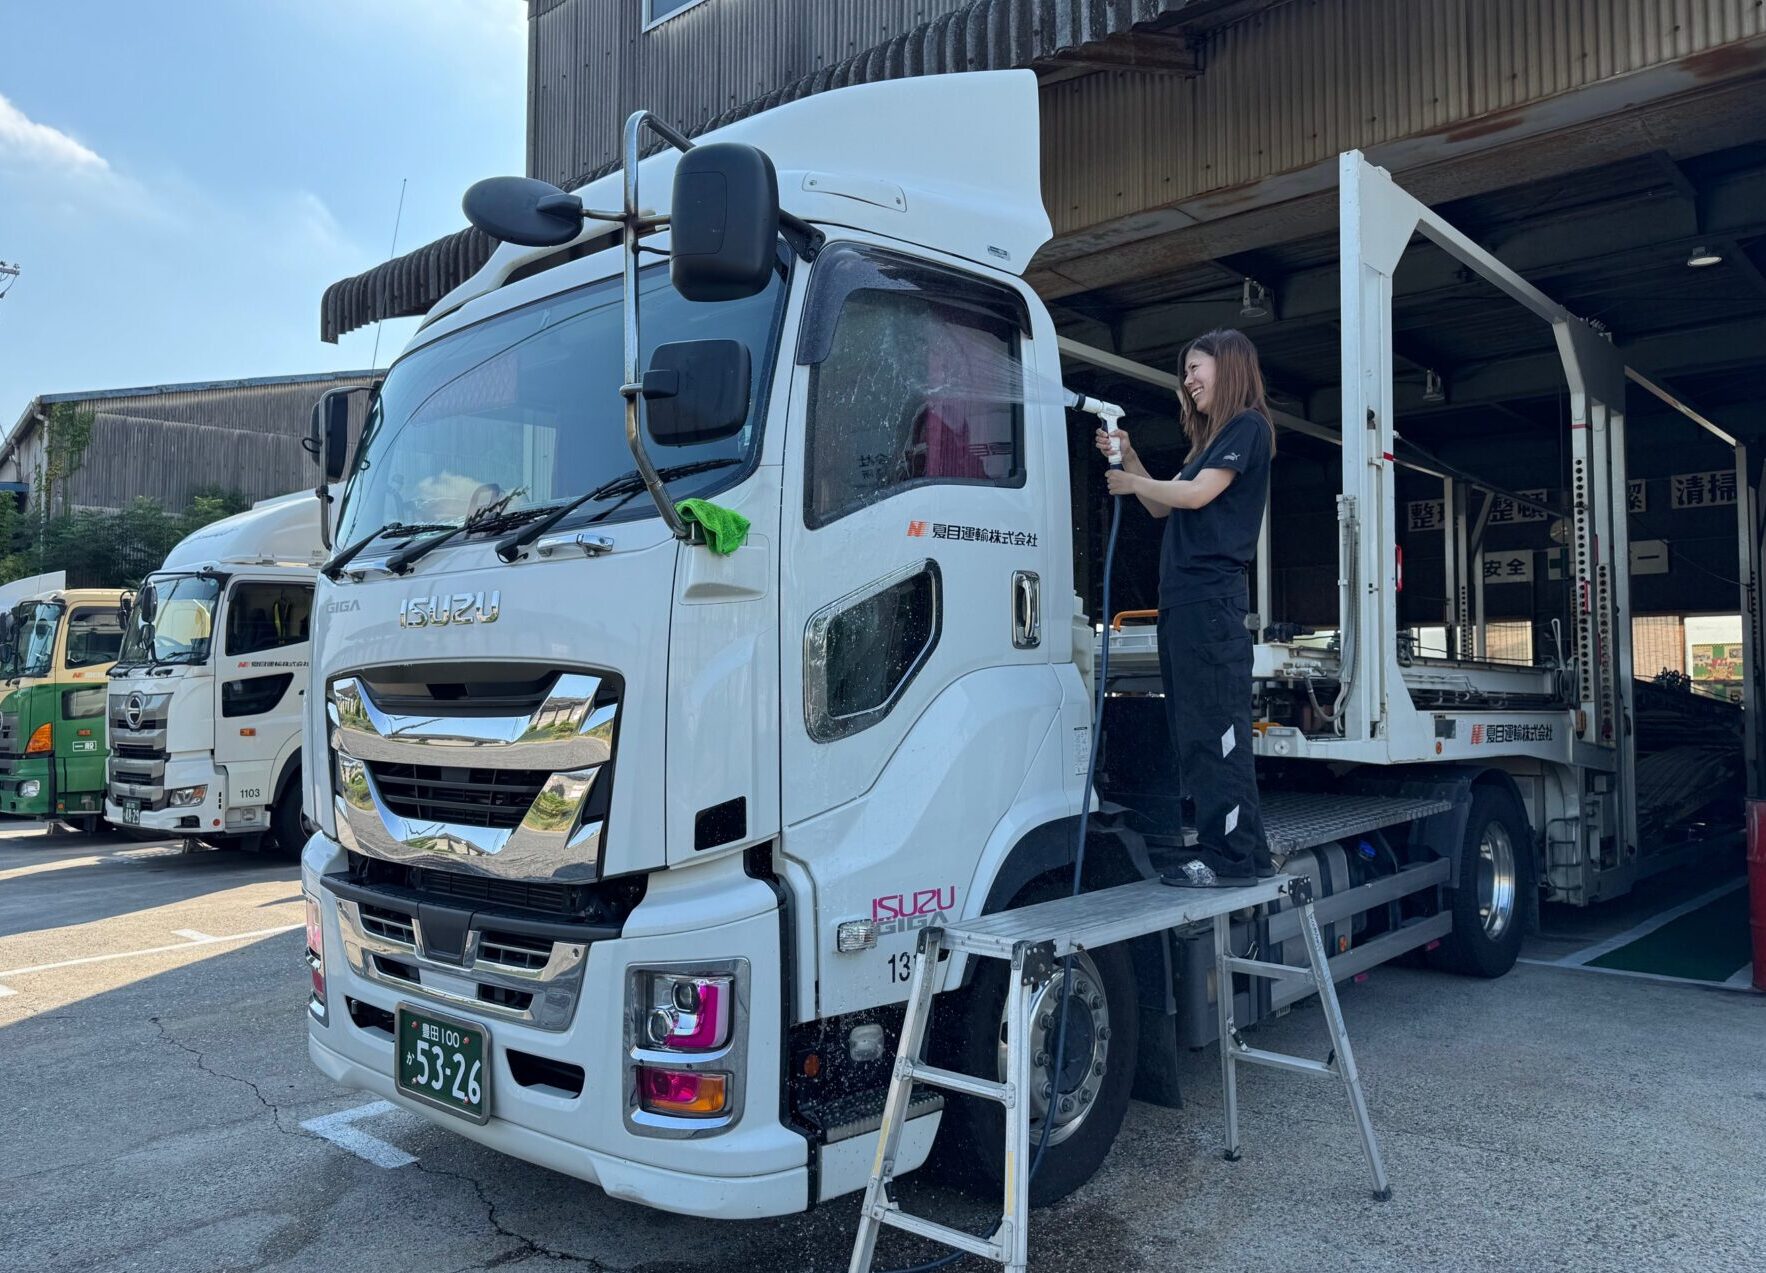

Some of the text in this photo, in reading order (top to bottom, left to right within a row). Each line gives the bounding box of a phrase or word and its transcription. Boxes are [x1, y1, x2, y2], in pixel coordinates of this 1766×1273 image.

[1675, 473, 1737, 506] 清掃
[932, 523, 1038, 547] 夏目運輸株式会社
[1484, 558, 1526, 577] 安全
[327, 599, 361, 614] GIGA
[400, 590, 500, 629] ISUZU
[1486, 723, 1553, 743] 夏目運輸株式会社
[240, 788, 260, 798] 1103
[872, 885, 955, 923] ISUZU
[876, 911, 948, 937] GIGA
[887, 951, 917, 984] 13
[441, 1028, 460, 1048] 100
[406, 1039, 481, 1105] か 53-26
